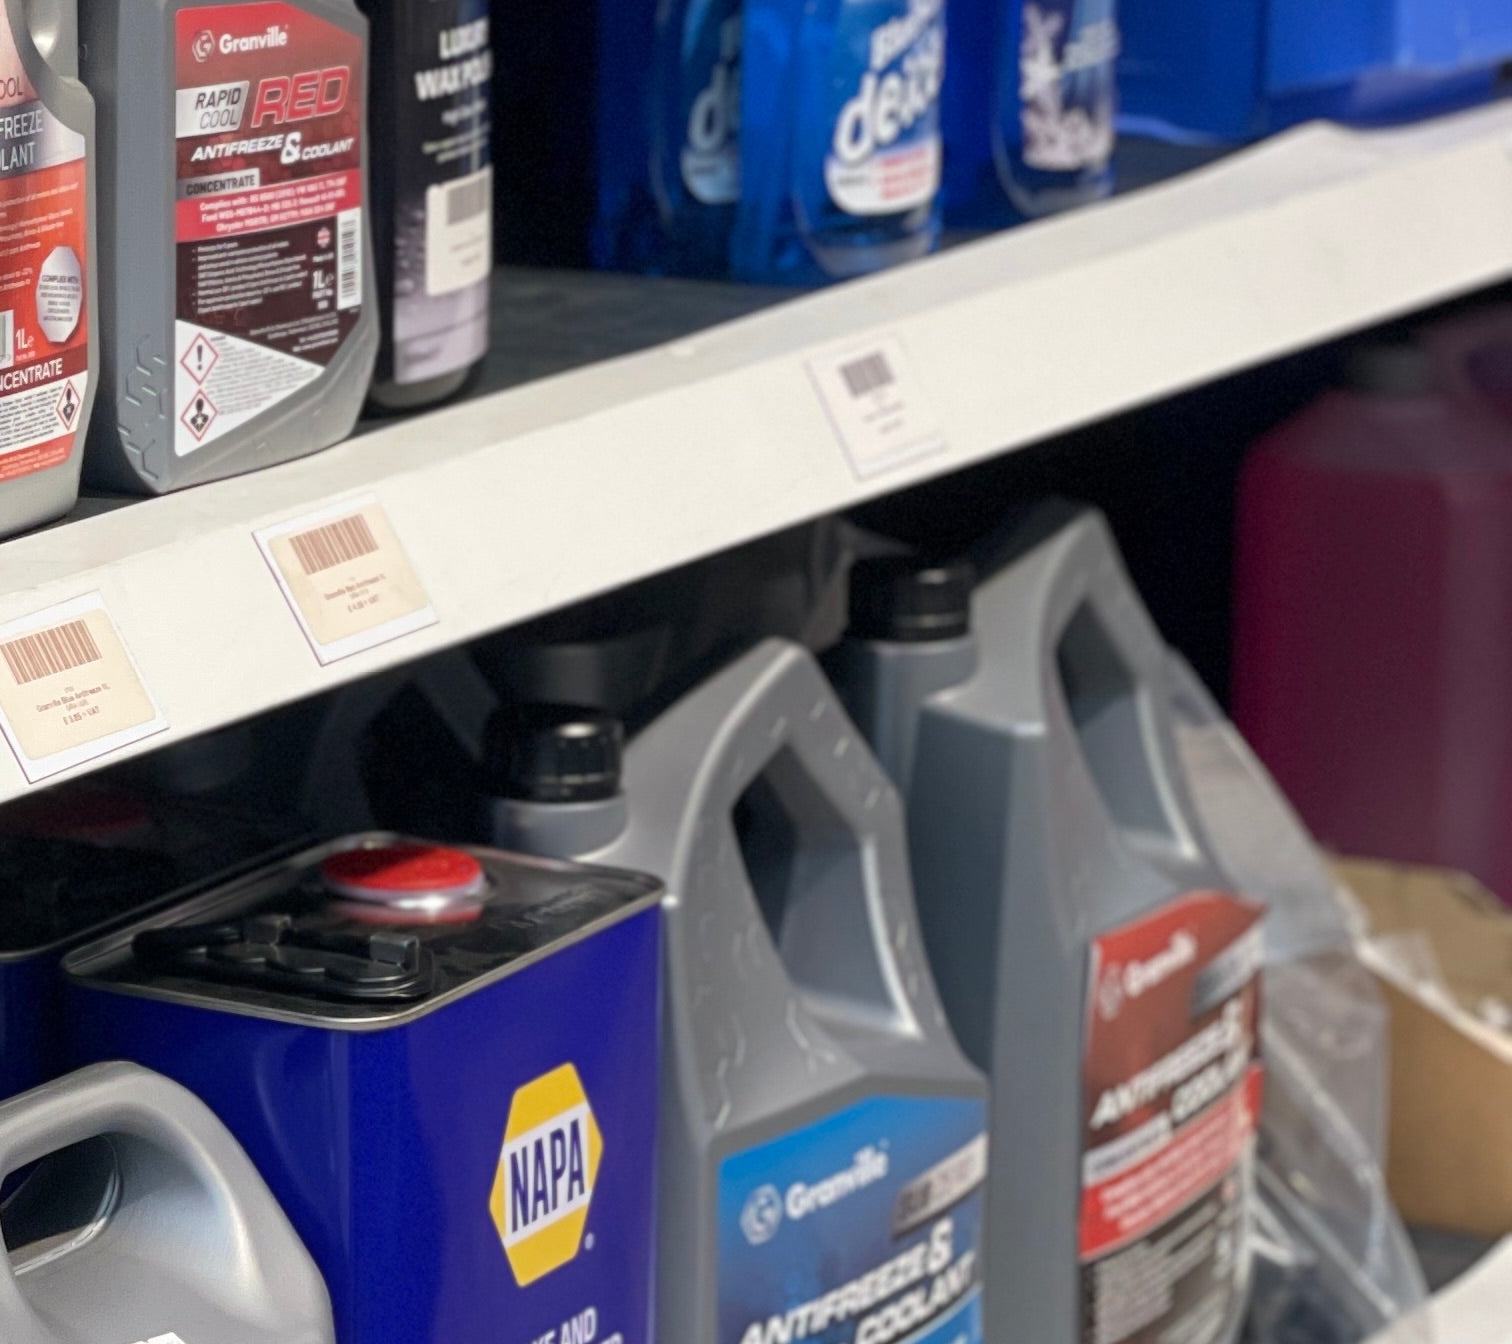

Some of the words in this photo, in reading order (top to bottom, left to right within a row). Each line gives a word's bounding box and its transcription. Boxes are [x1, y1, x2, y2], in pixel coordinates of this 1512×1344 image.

[219, 25, 287, 55] Granville
[194, 87, 241, 110] RAPID
[250, 65, 350, 128] RED
[200, 108, 238, 130] COOL
[191, 134, 284, 162] ANTIFREEZE
[302, 138, 354, 161] COOLANT
[186, 174, 256, 196] CONCENTRATE
[510, 1118, 586, 1235] NAPA
